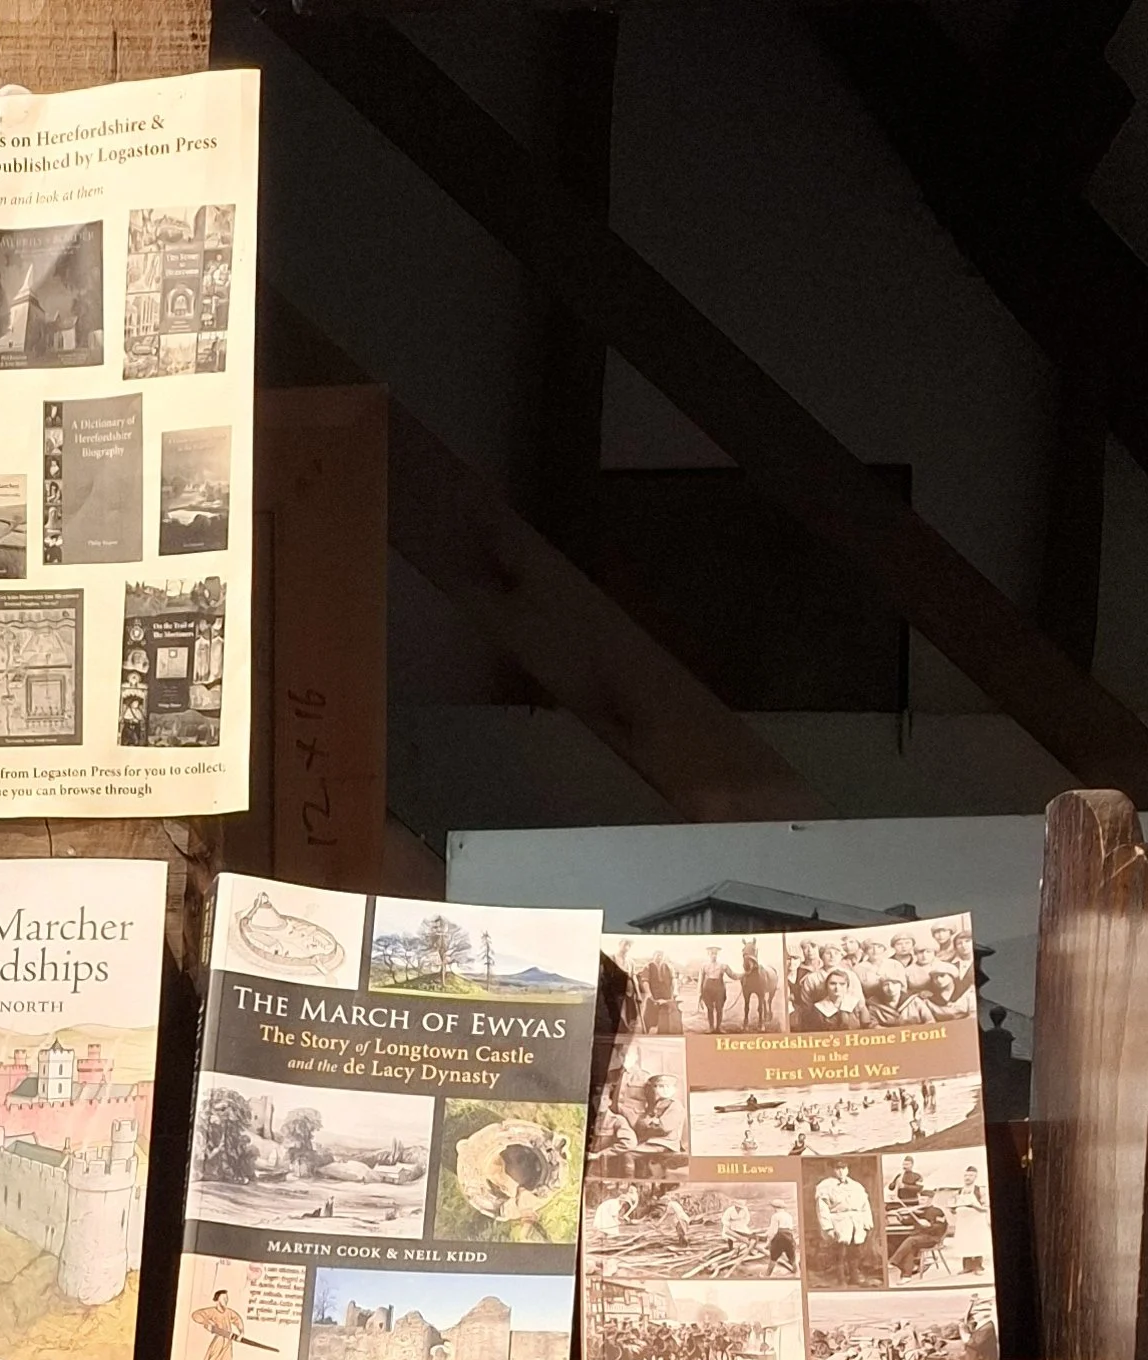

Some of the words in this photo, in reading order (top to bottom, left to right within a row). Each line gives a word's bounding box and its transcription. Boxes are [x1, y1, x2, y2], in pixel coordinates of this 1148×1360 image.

[11, 135, 31, 148] on
[36, 116, 147, 148] Herefordshire
[151, 114, 165, 130] &
[75, 150, 93, 169] by
[97, 141, 170, 165] Logaston
[175, 134, 218, 154] Press
[846, 1031, 897, 1047] Home
[900, 1025, 947, 1044] Front
[764, 1066, 804, 1081] First
[808, 1064, 866, 1080] World
[869, 1063, 900, 1078] War
[716, 1162, 740, 1174] Bill
[744, 1163, 774, 1174] Laws
[266, 1240, 332, 1257] MARTIN
[336, 1245, 381, 1260] COOK
[386, 1247, 399, 1260] &
[403, 1248, 441, 1262] NEIL
[446, 1250, 488, 1263] KIDD
